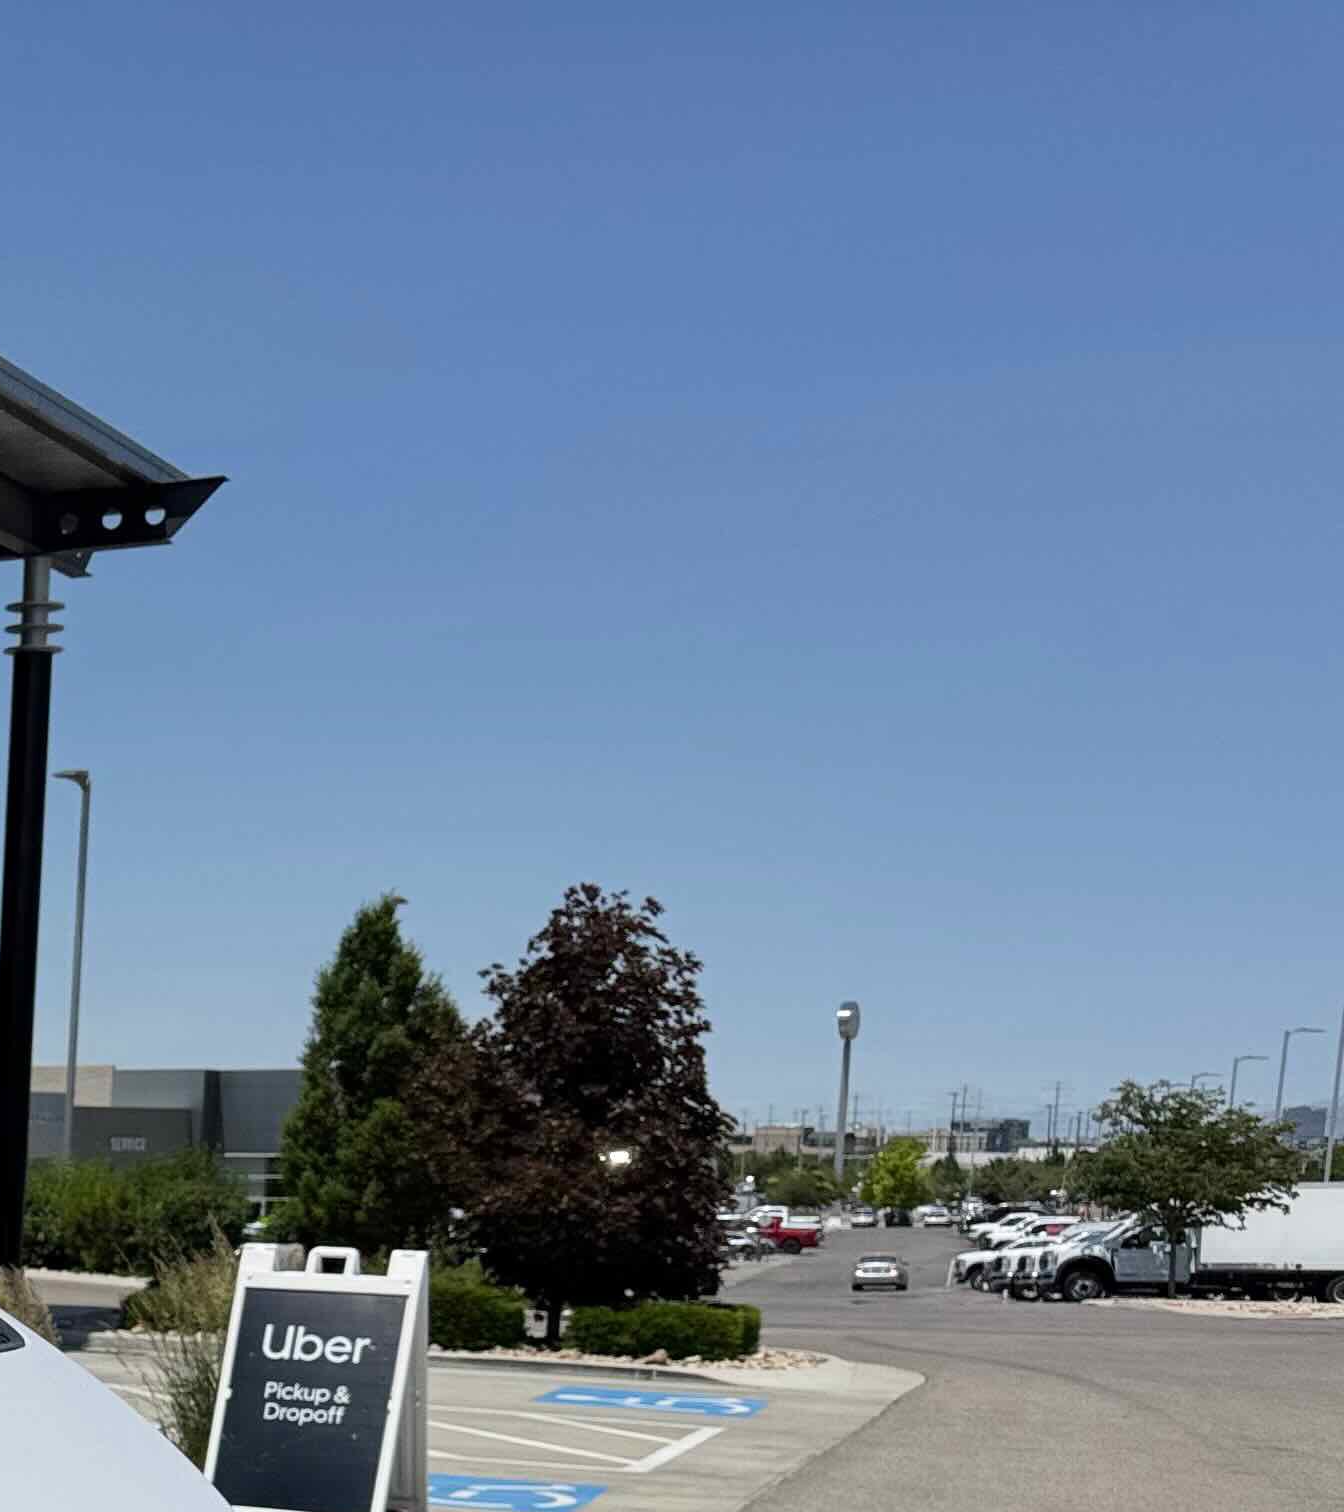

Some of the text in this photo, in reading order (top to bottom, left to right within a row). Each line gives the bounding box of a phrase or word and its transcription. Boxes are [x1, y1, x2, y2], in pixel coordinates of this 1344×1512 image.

[261, 1323, 371, 1364] Uber
[263, 1380, 351, 1406] Pickup &
[263, 1401, 344, 1426] Dropoff
